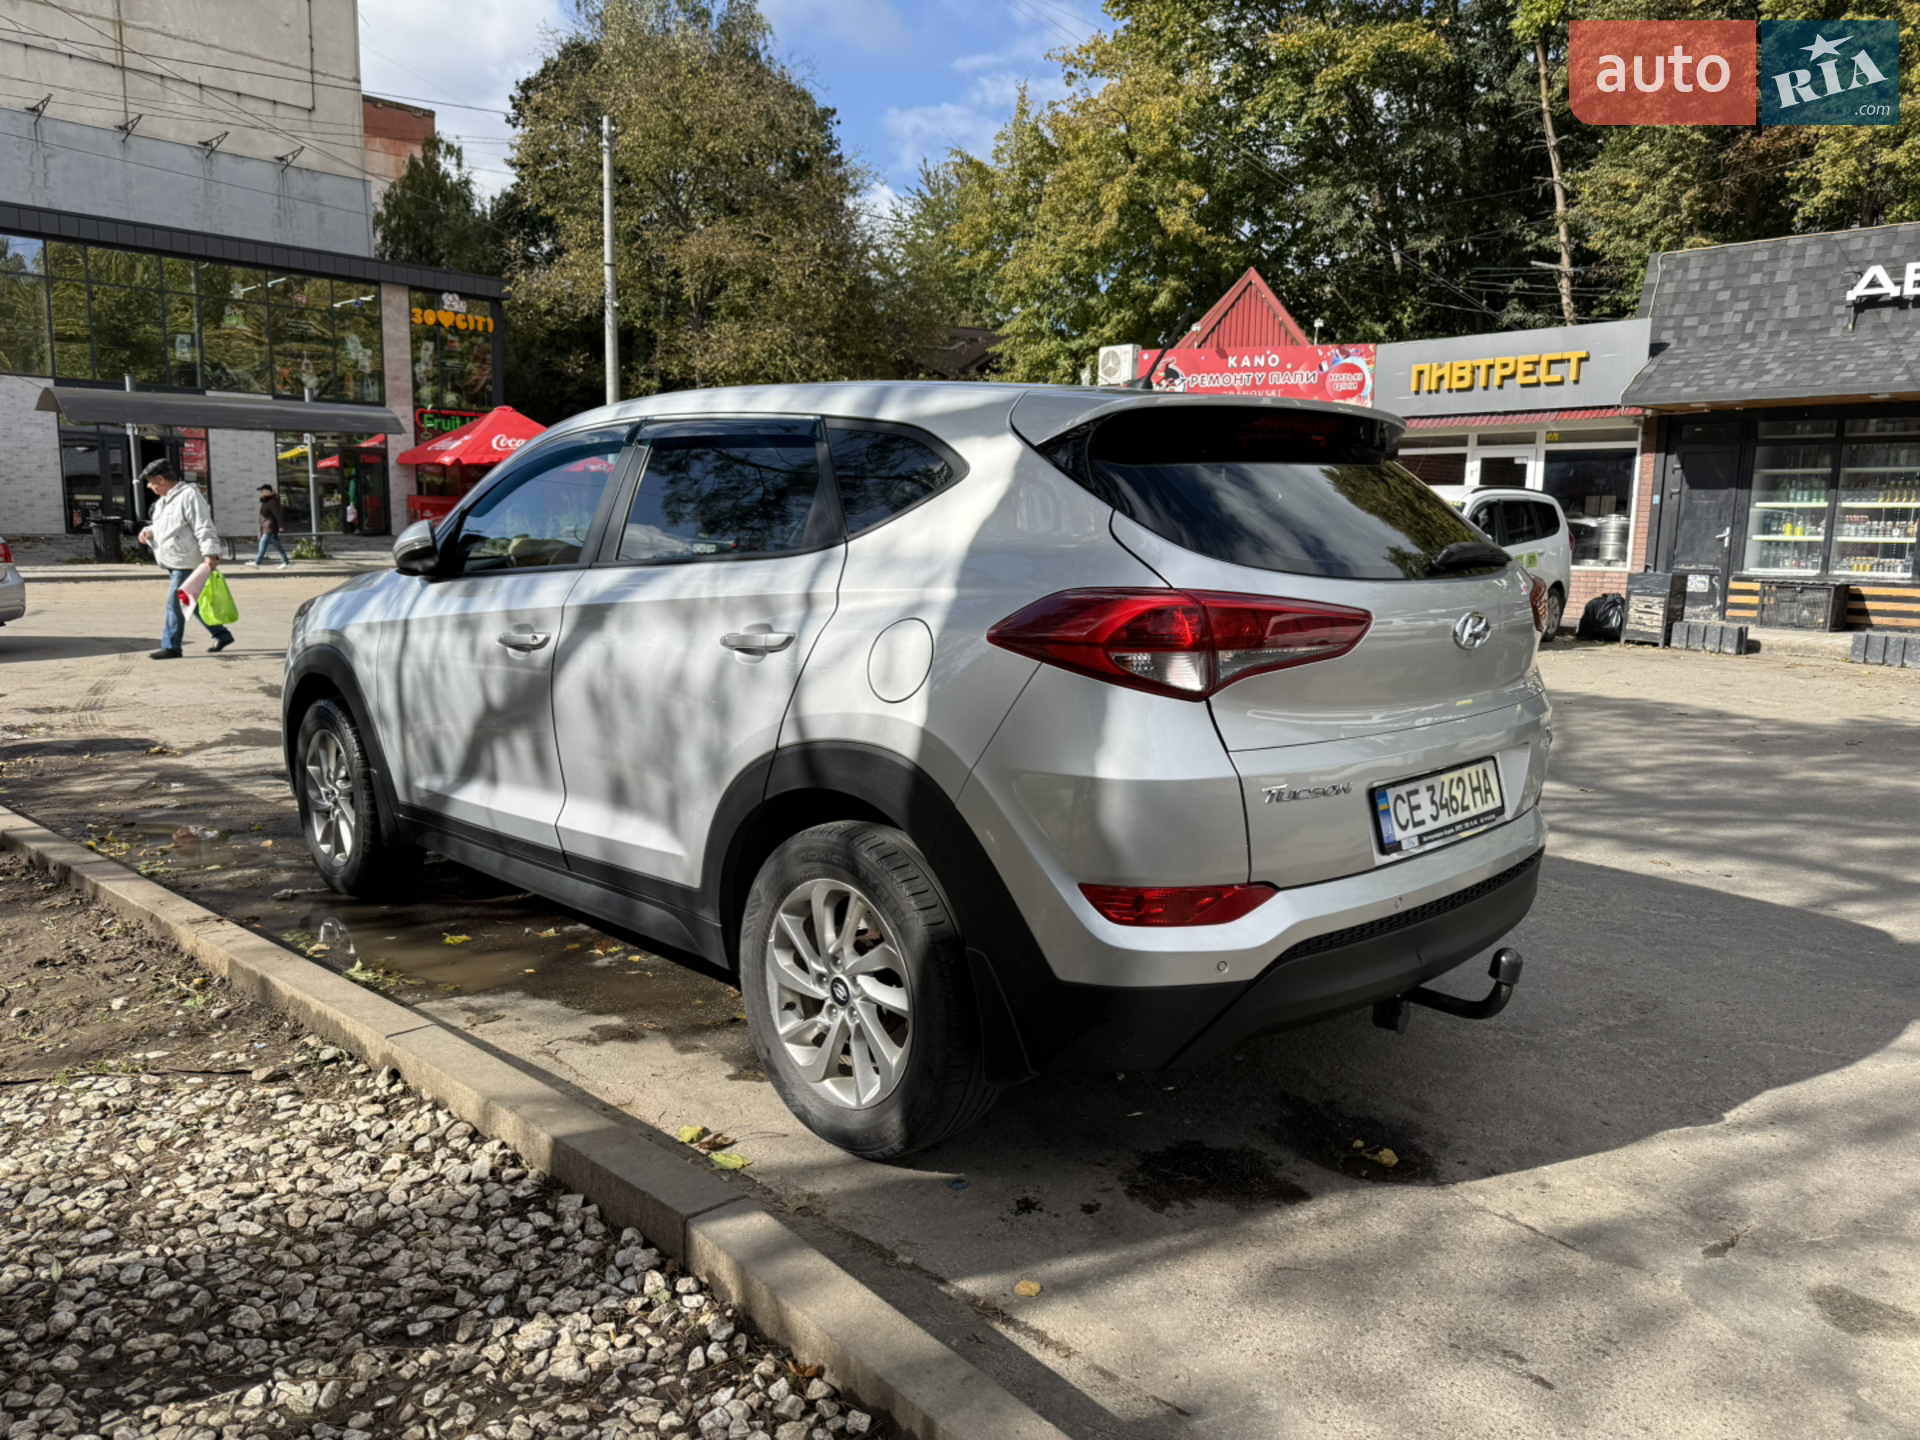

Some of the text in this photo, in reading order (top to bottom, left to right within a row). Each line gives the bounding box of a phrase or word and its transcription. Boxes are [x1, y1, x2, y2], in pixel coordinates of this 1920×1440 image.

[1228, 354, 1281, 369] KANO
[1189, 372, 1253, 388] РЕМОНТ
[1268, 370, 1318, 385] ПАПИ
[1329, 372, 1363, 382] НИЗЬКІ
[1410, 350, 1590, 393] ПИВТРЕСТ
[423, 413, 461, 432] Fruit
[1262, 782, 1353, 804] TUCSON
